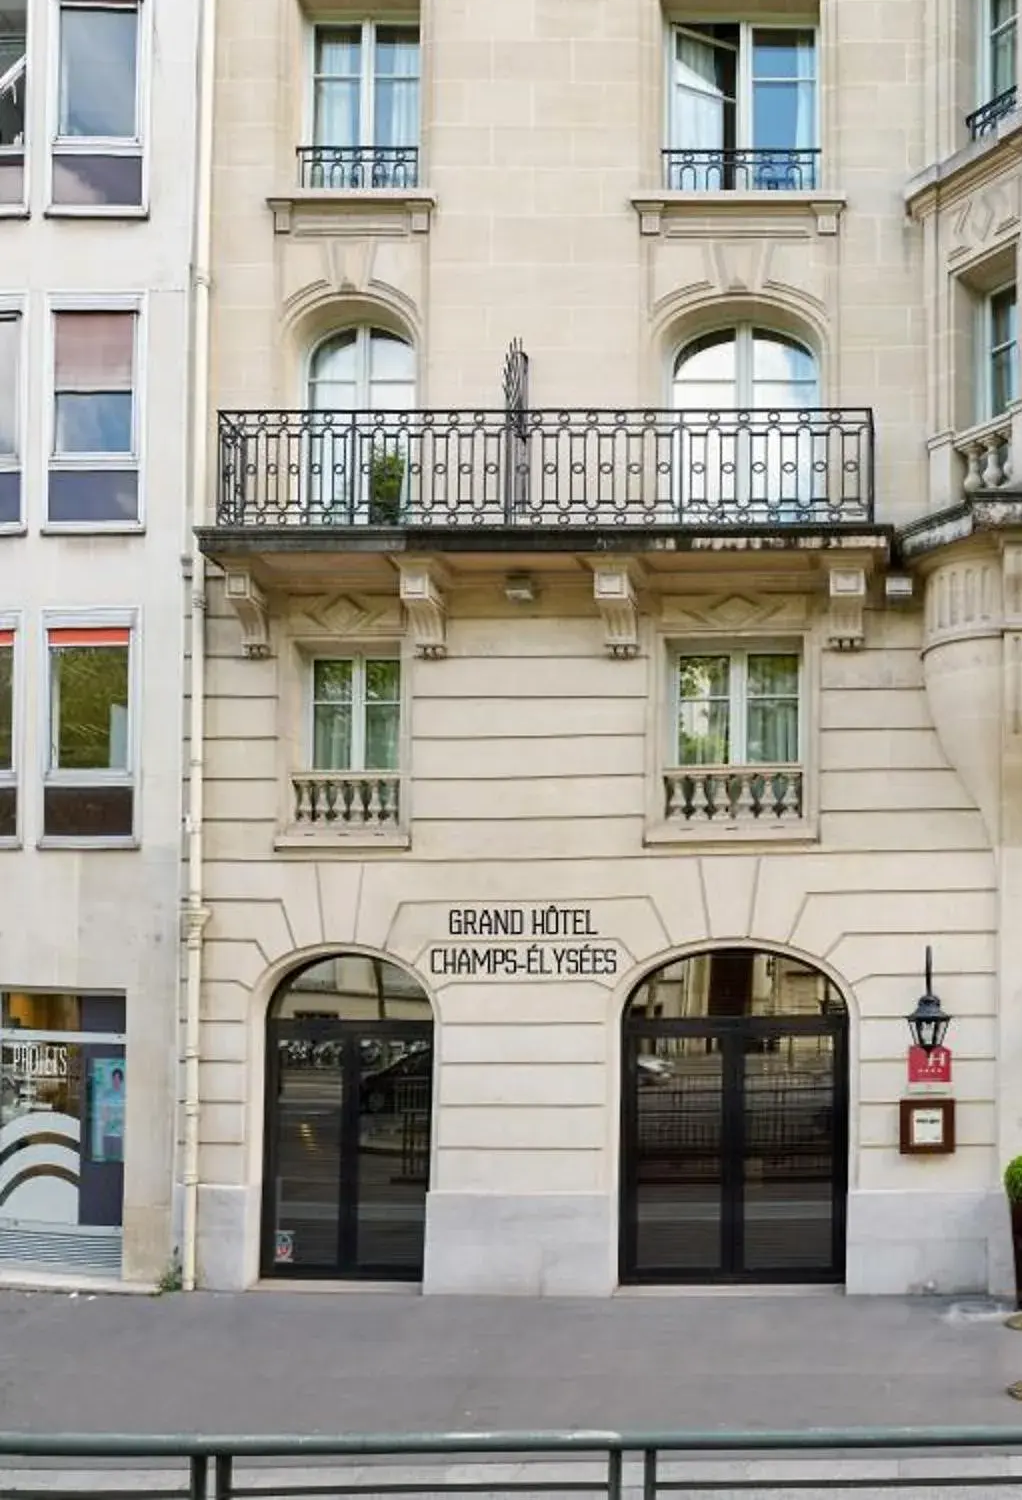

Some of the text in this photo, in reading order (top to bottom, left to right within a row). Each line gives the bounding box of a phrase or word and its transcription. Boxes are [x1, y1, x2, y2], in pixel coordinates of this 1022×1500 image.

[449, 905, 598, 935] GRAND HÔTEL
[430, 944, 617, 975] CHAMPS-ÉLYSÉES
[927, 1052, 946, 1067] H
